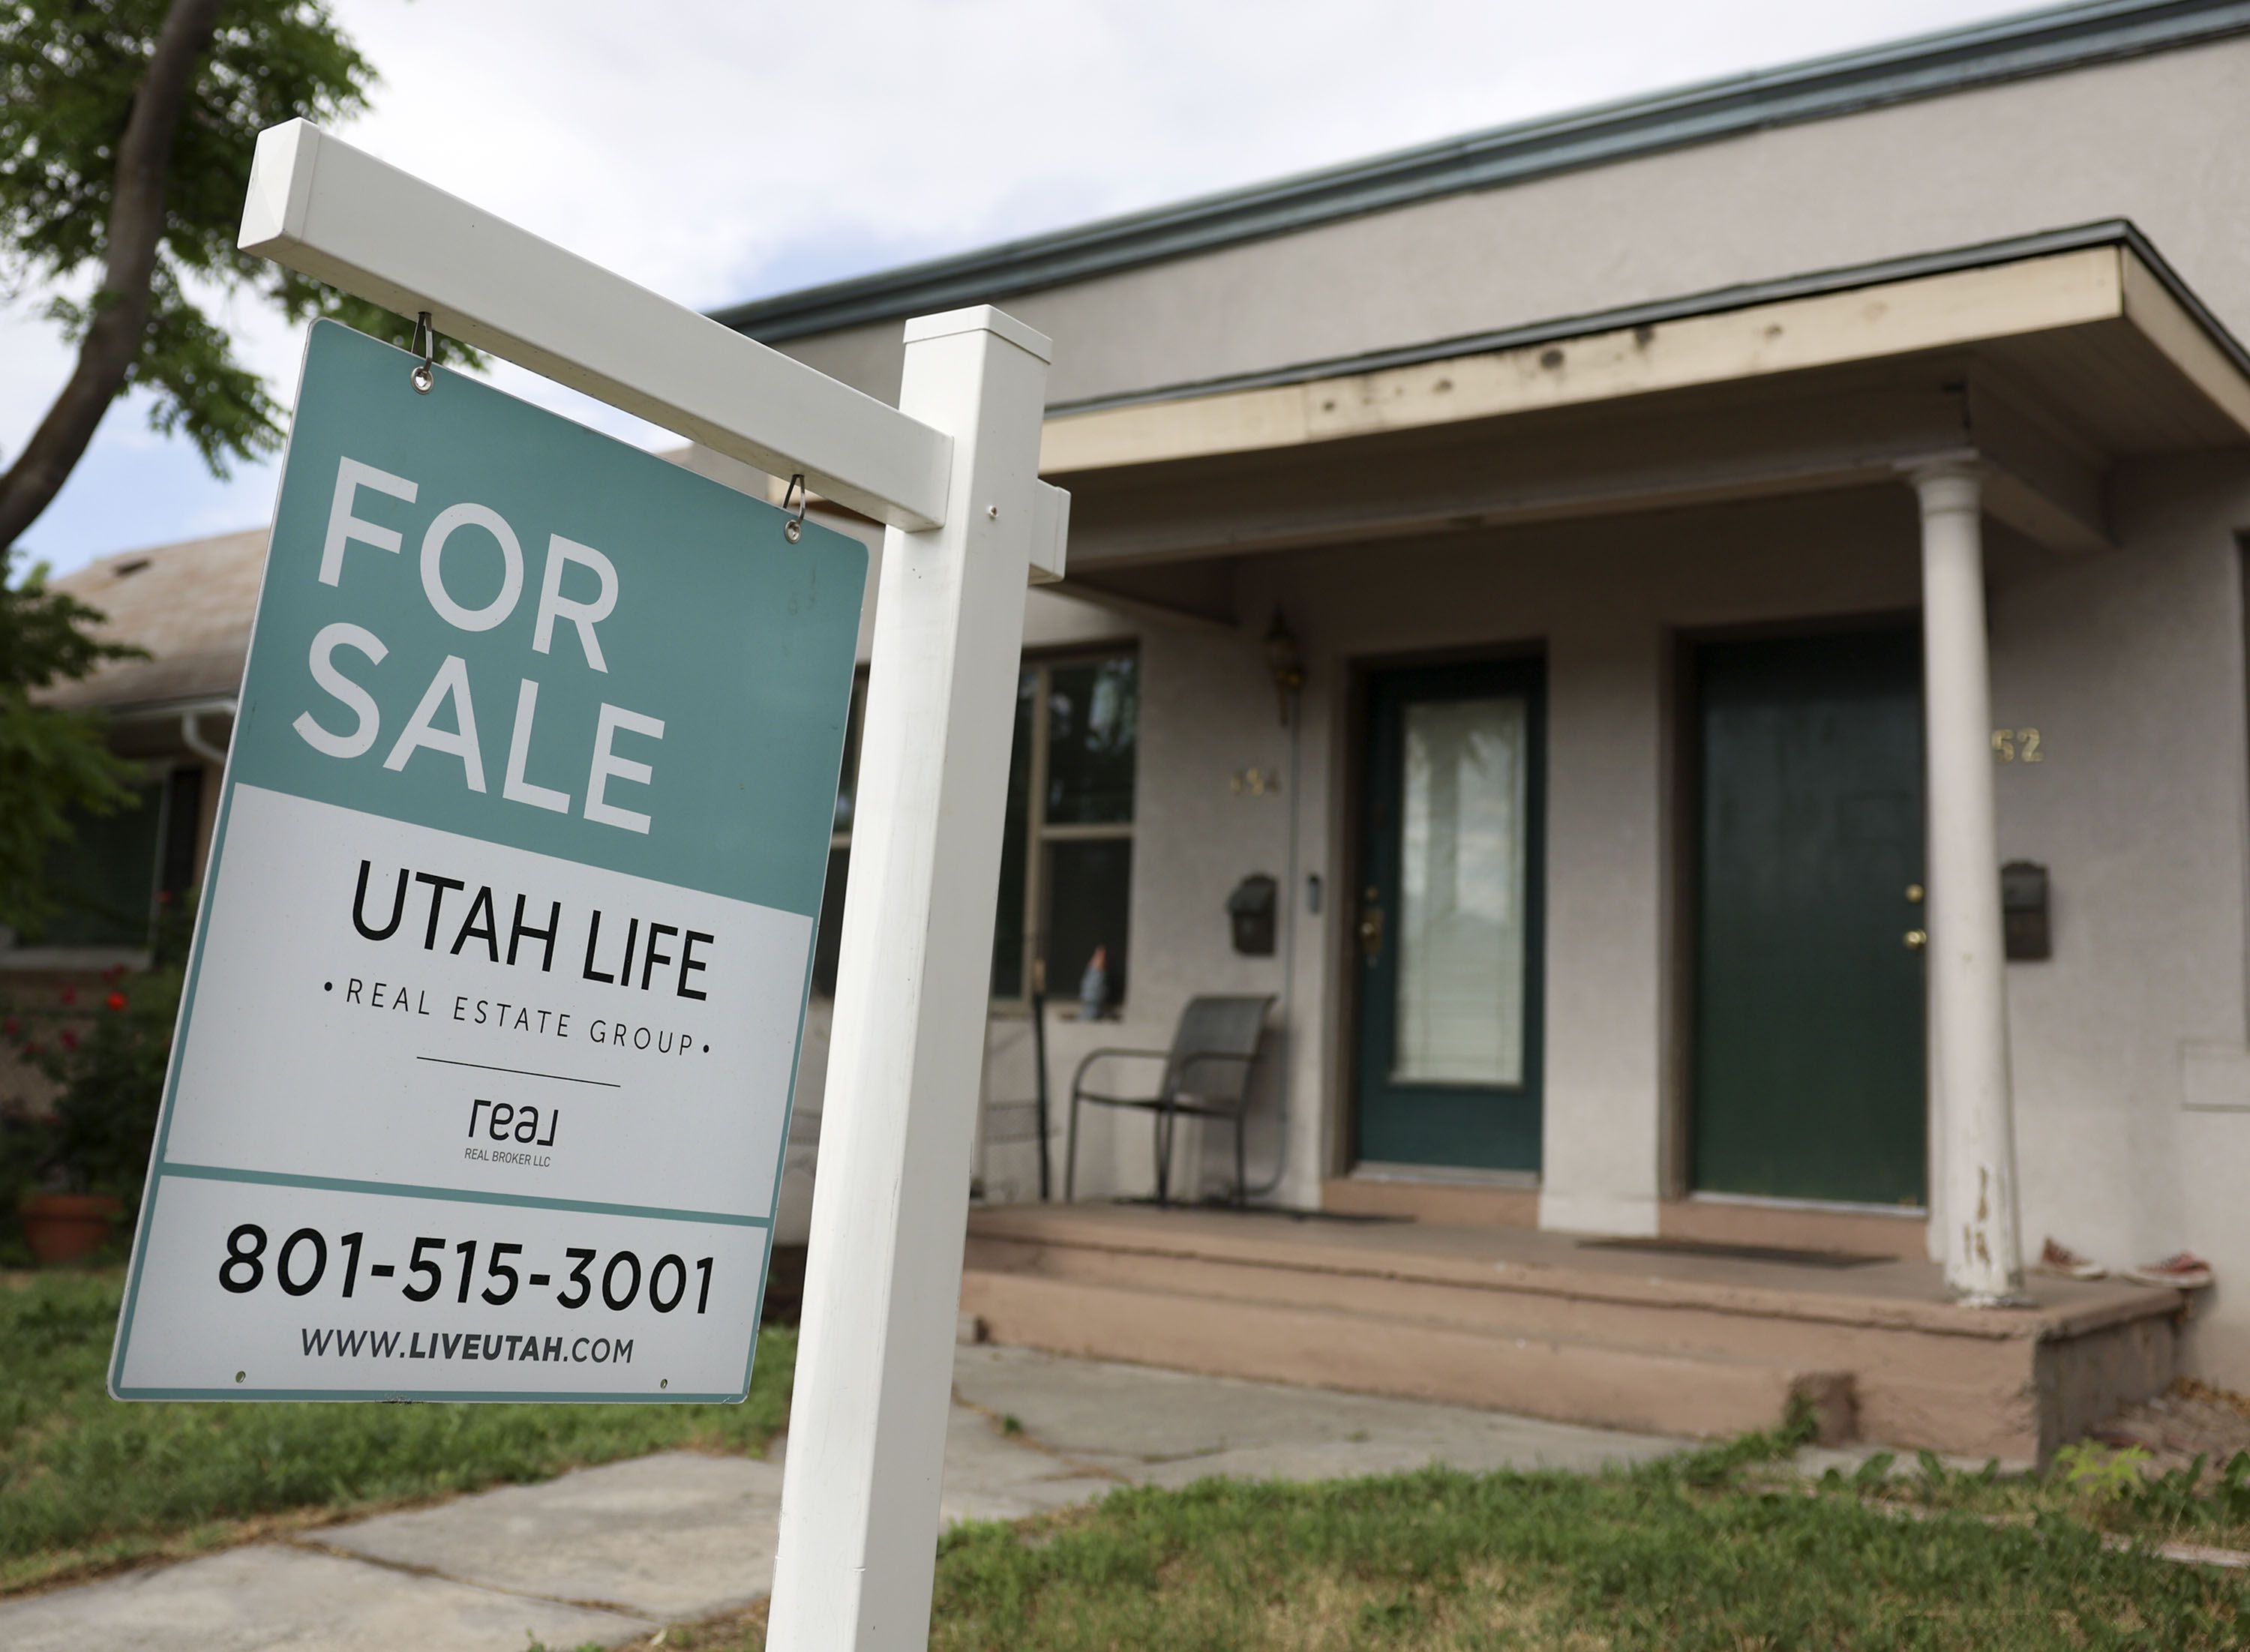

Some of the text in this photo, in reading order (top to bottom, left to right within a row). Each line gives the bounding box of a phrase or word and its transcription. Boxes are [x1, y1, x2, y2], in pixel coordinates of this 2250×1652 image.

[319, 455, 619, 674] FOR
[292, 622, 665, 835] SALE
[352, 859, 715, 1001] UTAH LIFE
[346, 978, 693, 1056] REAL ESTATE GROUP
[464, 1147, 550, 1167] REAL BROKER LLC
[468, 1099, 559, 1147] real
[218, 1223, 714, 1314] 801-515-3001
[301, 1327, 634, 1364] WWW.LIVEUTAH.COM
